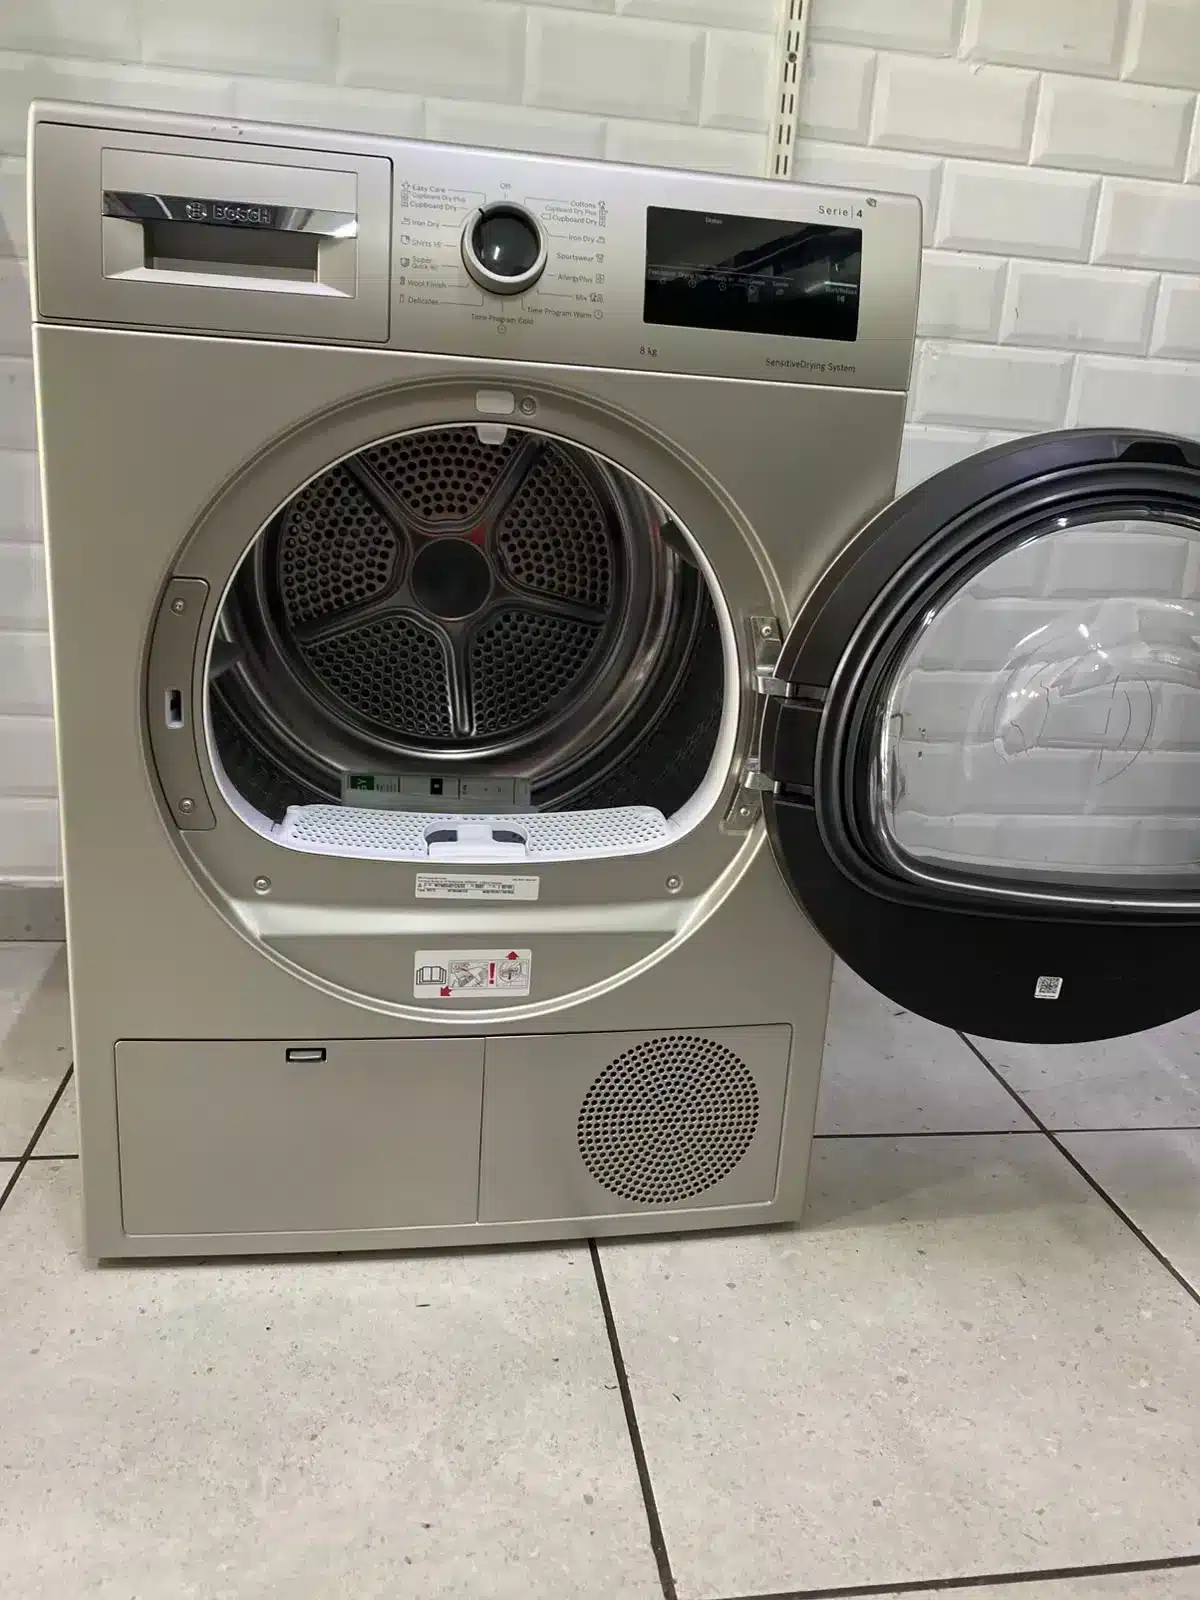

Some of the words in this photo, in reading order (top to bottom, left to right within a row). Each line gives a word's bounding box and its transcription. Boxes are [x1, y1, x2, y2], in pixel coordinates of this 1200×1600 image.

[410, 201, 443, 210] Cupboard
[445, 203, 456, 212] Dry
[570, 200, 596, 208] Cottons
[212, 204, 271, 224] BOSCH
[818, 205, 848, 216] Serie
[856, 209, 863, 218] 4
[427, 220, 440, 228] Dry
[552, 214, 584, 223] Cupboard
[586, 218, 597, 226] Dry
[569, 233, 581, 241] Iron
[583, 235, 595, 243] Dry
[412, 240, 432, 248] Shirts
[412, 255, 432, 264] Super
[527, 306, 542, 314] Time
[545, 308, 572, 319] Program
[573, 310, 592, 319] Warm
[488, 315, 516, 324] Program
[640, 346, 646, 355] 8
[647, 346, 658, 357] kg
[765, 358, 826, 372] SensitiveDrying
[828, 362, 856, 373] System
